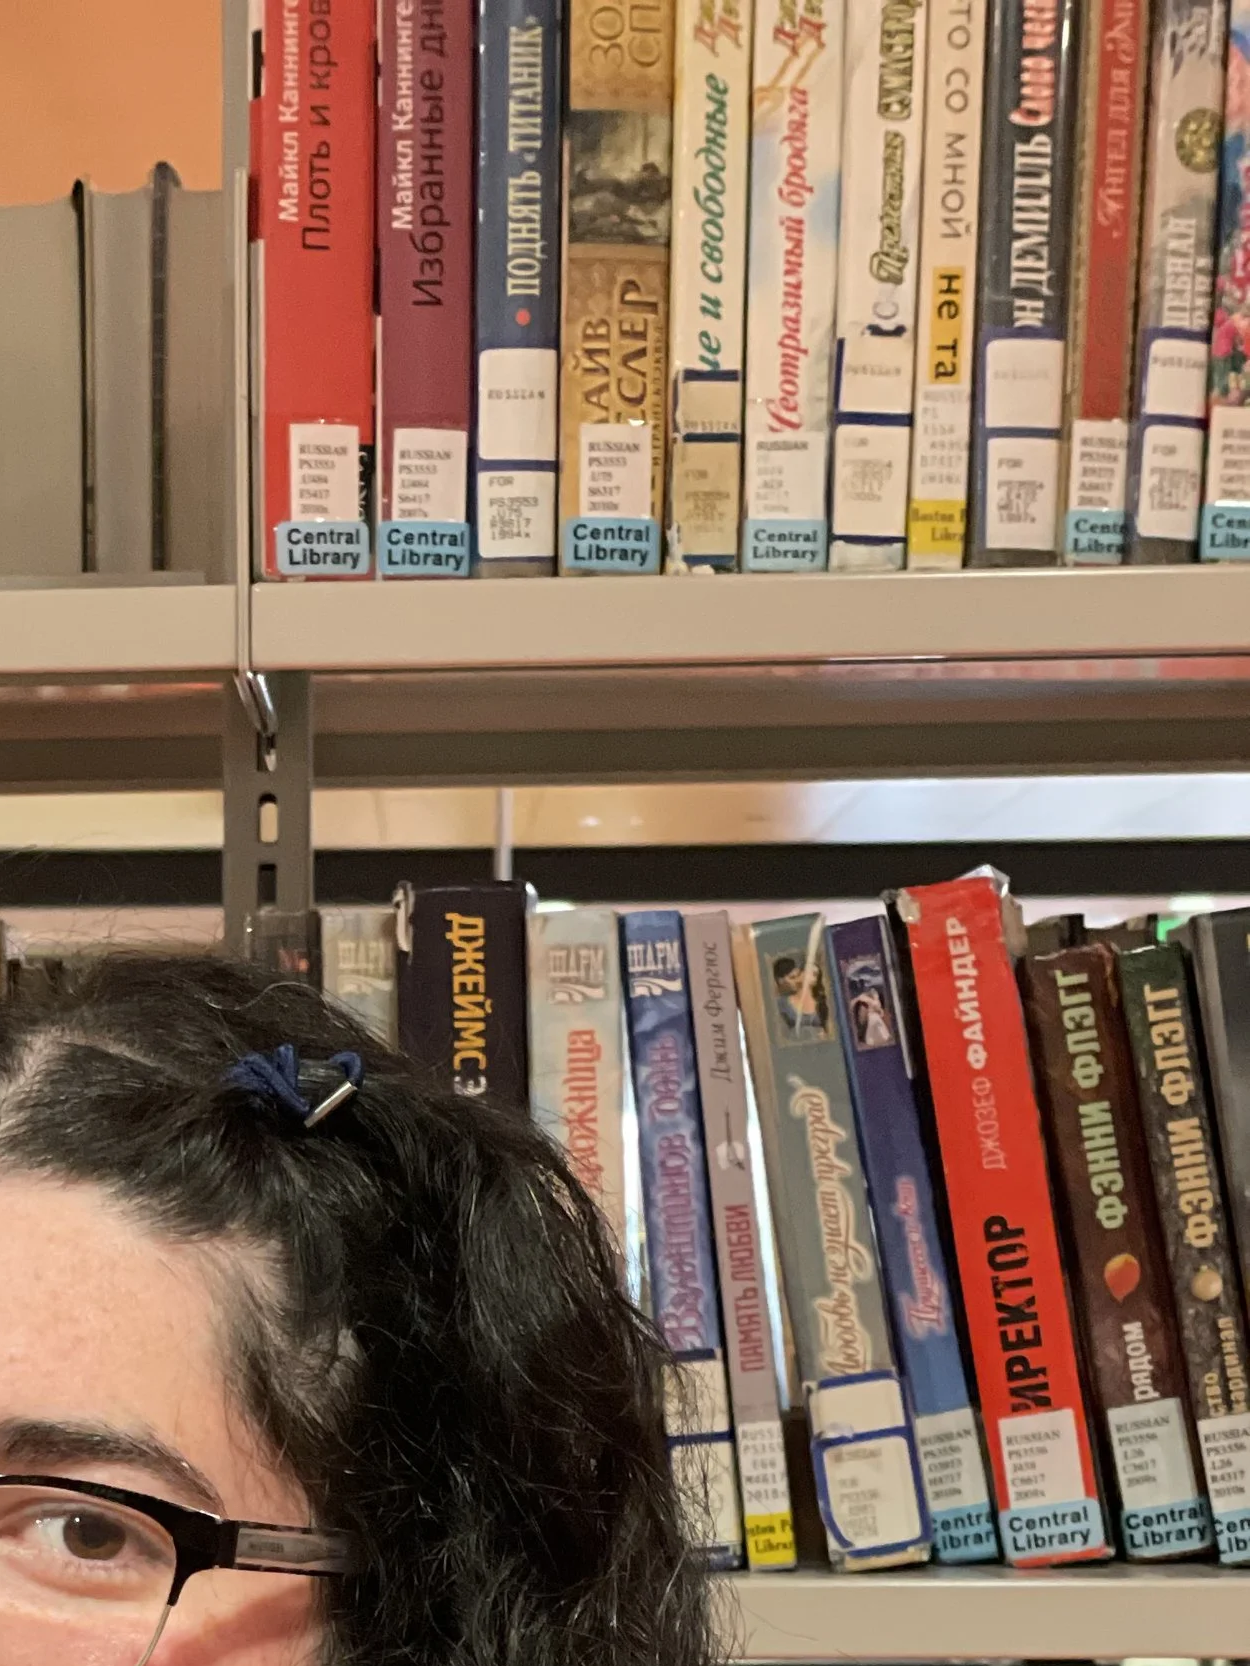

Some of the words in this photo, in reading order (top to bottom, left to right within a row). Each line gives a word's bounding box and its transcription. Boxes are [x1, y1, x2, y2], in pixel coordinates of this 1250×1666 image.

[309, 105, 331, 126] и
[944, 67, 971, 114] СО
[277, 132, 300, 223] Майкл
[391, 140, 414, 230] Майкл
[694, 72, 729, 284] свободные
[778, 87, 814, 209] бродяга
[940, 131, 974, 240] МНОЙ
[301, 141, 332, 252] Плоть
[410, 70, 450, 307] Избранные
[1010, 133, 1056, 296] ДЕМИЛЛЬ
[507, 170, 548, 297] ПОДНЯТЬ
[698, 294, 722, 322] и
[935, 273, 962, 320] не
[572, 317, 611, 426] АЙВ
[286, 527, 361, 545] Central
[288, 549, 362, 570] Library
[386, 528, 466, 548] Central
[387, 549, 465, 571] Library
[572, 522, 651, 544] Central
[573, 543, 650, 567] Library
[752, 546, 819, 562] Library
[753, 528, 819, 544] Central
[446, 911, 493, 1071] ДЖЕЙМС
[627, 938, 682, 973] ШАРМ
[700, 940, 727, 1018] Фергюс
[945, 915, 989, 1071] ФАЙНДЕР
[709, 1022, 735, 1084] Джим
[1055, 968, 1106, 1089] ФЛЭГГ
[1143, 982, 1195, 1106] ФЛЭГГ
[973, 1075, 1010, 1172] ДЖОЗЕФ
[1077, 1100, 1129, 1229] ФЭННИ
[1166, 1116, 1220, 1248] ФЭННИ
[723, 1203, 757, 1282] ЛЮБВИ
[736, 1287, 765, 1374] ПАМЯТЬ
[1122, 1320, 1159, 1401] рядом
[1008, 1505, 1091, 1533] Central
[1013, 1528, 1092, 1553] Library
[1125, 1503, 1206, 1531] Central
[1129, 1524, 1208, 1550] Library
